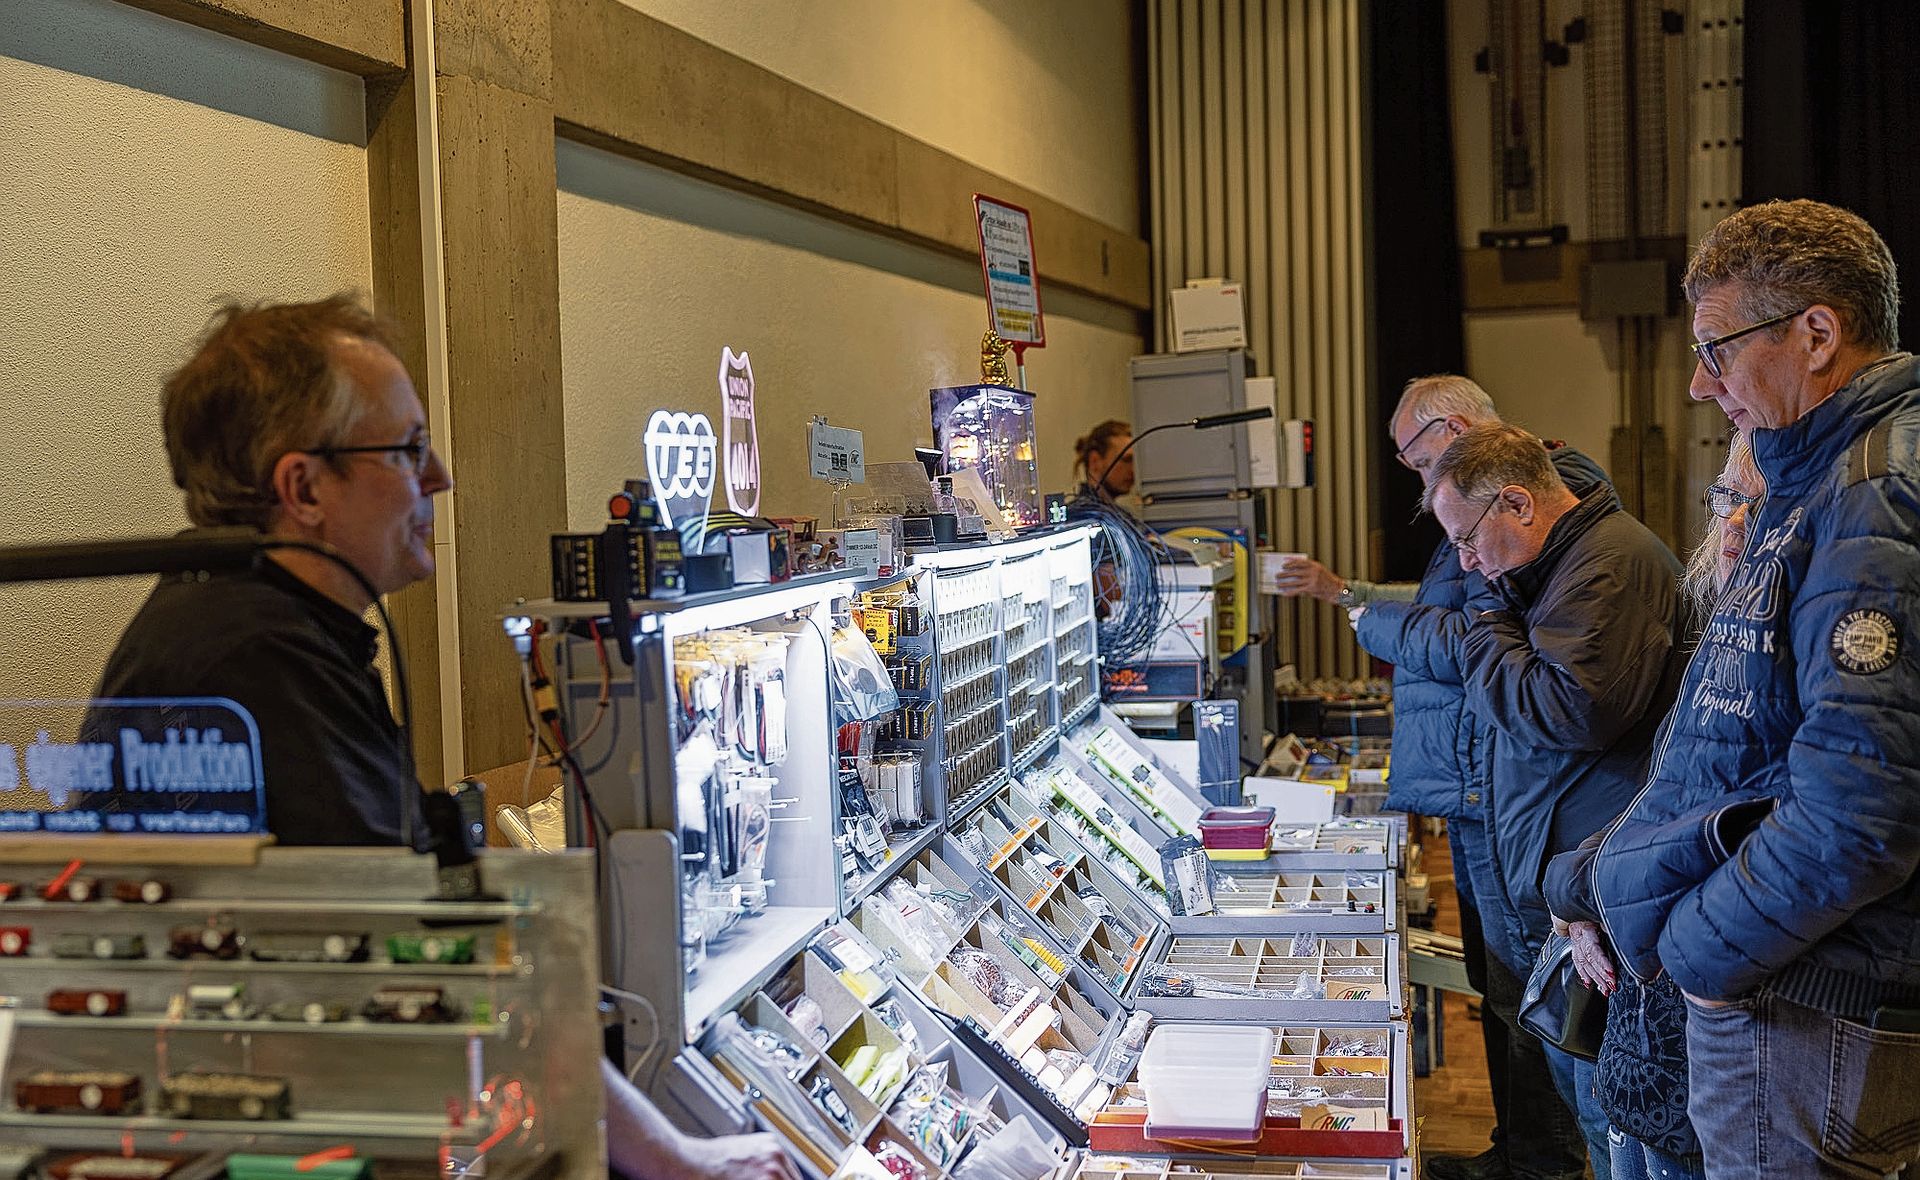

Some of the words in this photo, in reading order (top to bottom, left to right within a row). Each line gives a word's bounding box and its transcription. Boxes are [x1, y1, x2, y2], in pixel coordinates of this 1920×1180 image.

[729, 376, 750, 396] UNION
[649, 434, 713, 479] TEE
[731, 442, 758, 491] 4014
[1846, 610, 1865, 622] THE
[1868, 611, 1896, 634] ARCTIC
[1692, 679, 1756, 726] Original
[119, 727, 253, 793] Produktion
[1343, 990, 1371, 1000] RMC
[1320, 1116, 1355, 1131] RMC
